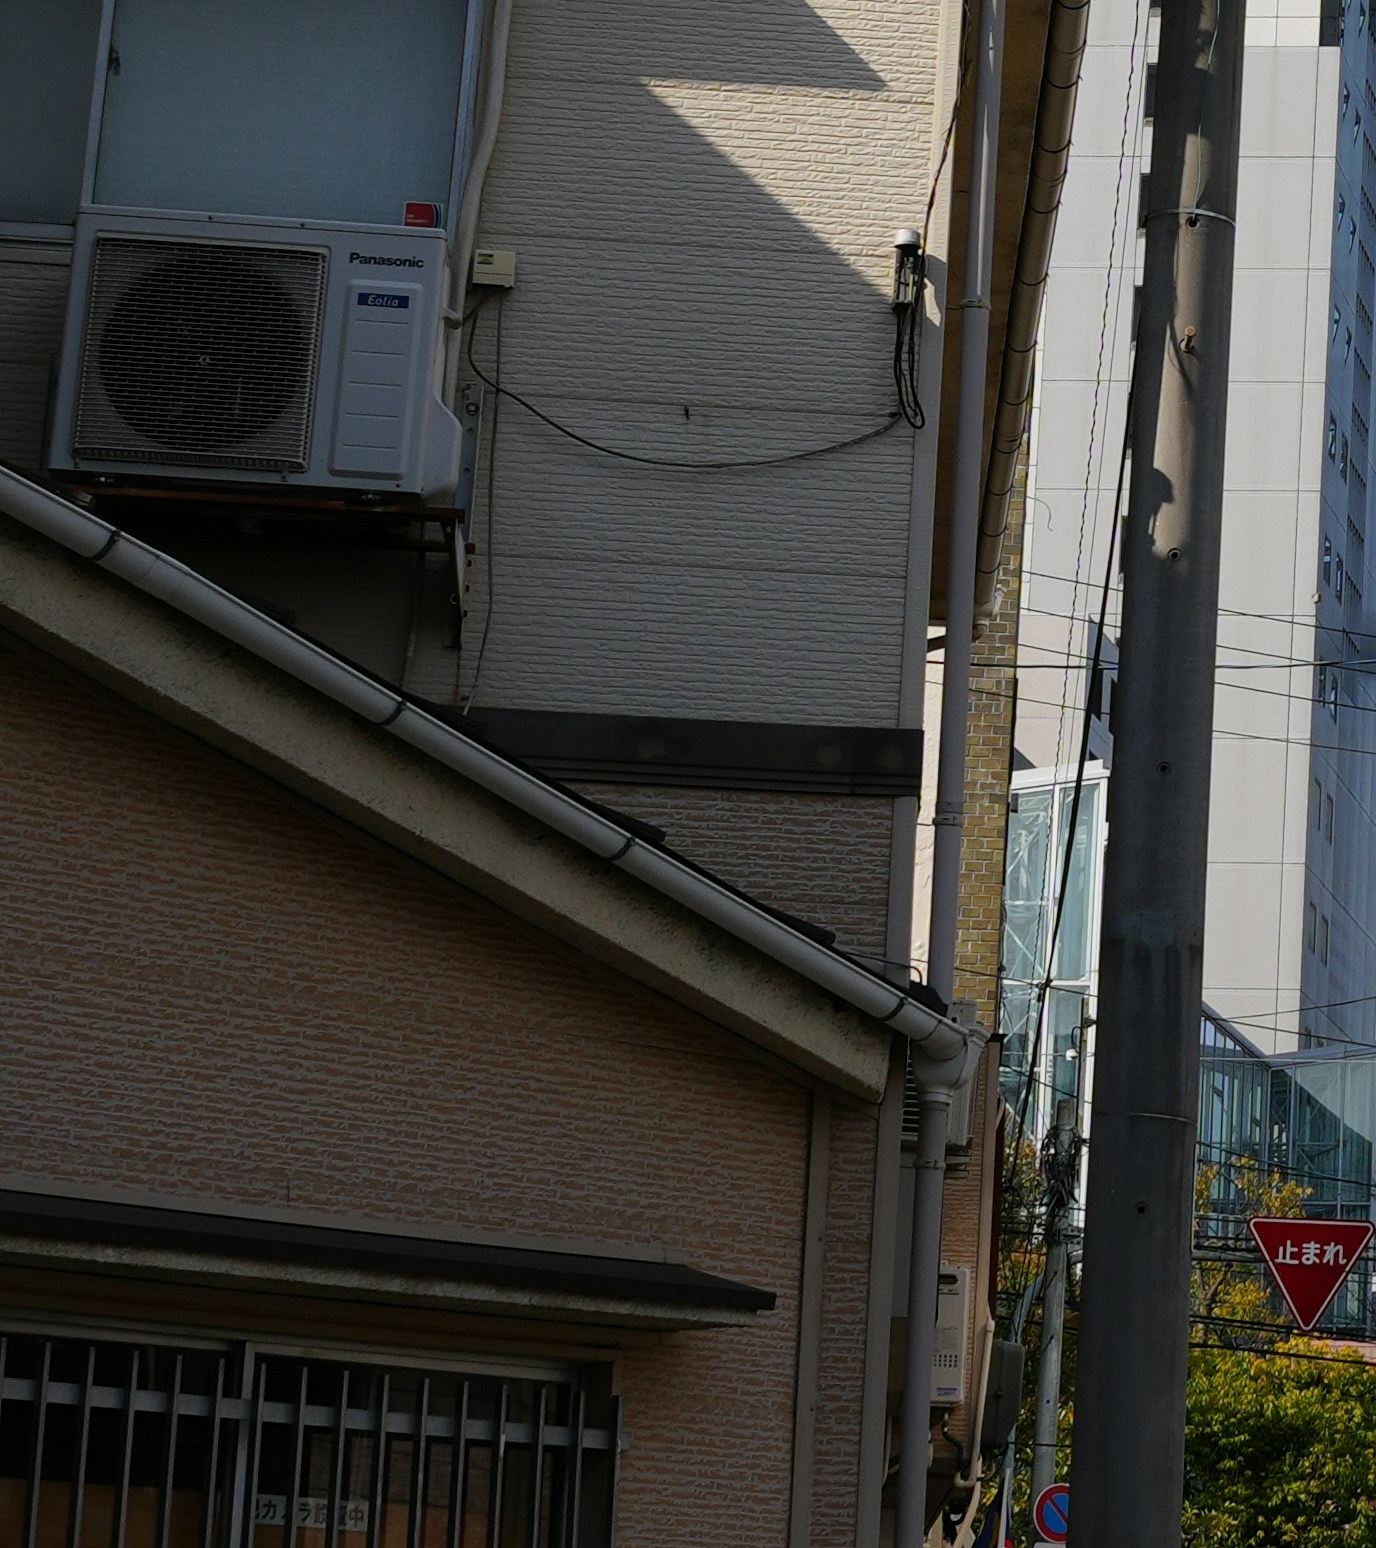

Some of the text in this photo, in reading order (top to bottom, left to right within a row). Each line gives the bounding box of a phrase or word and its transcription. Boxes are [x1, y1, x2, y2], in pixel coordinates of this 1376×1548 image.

[349, 251, 425, 268] Panasonic
[367, 294, 400, 307] Eolia
[1273, 1239, 1348, 1267] 止まれ
